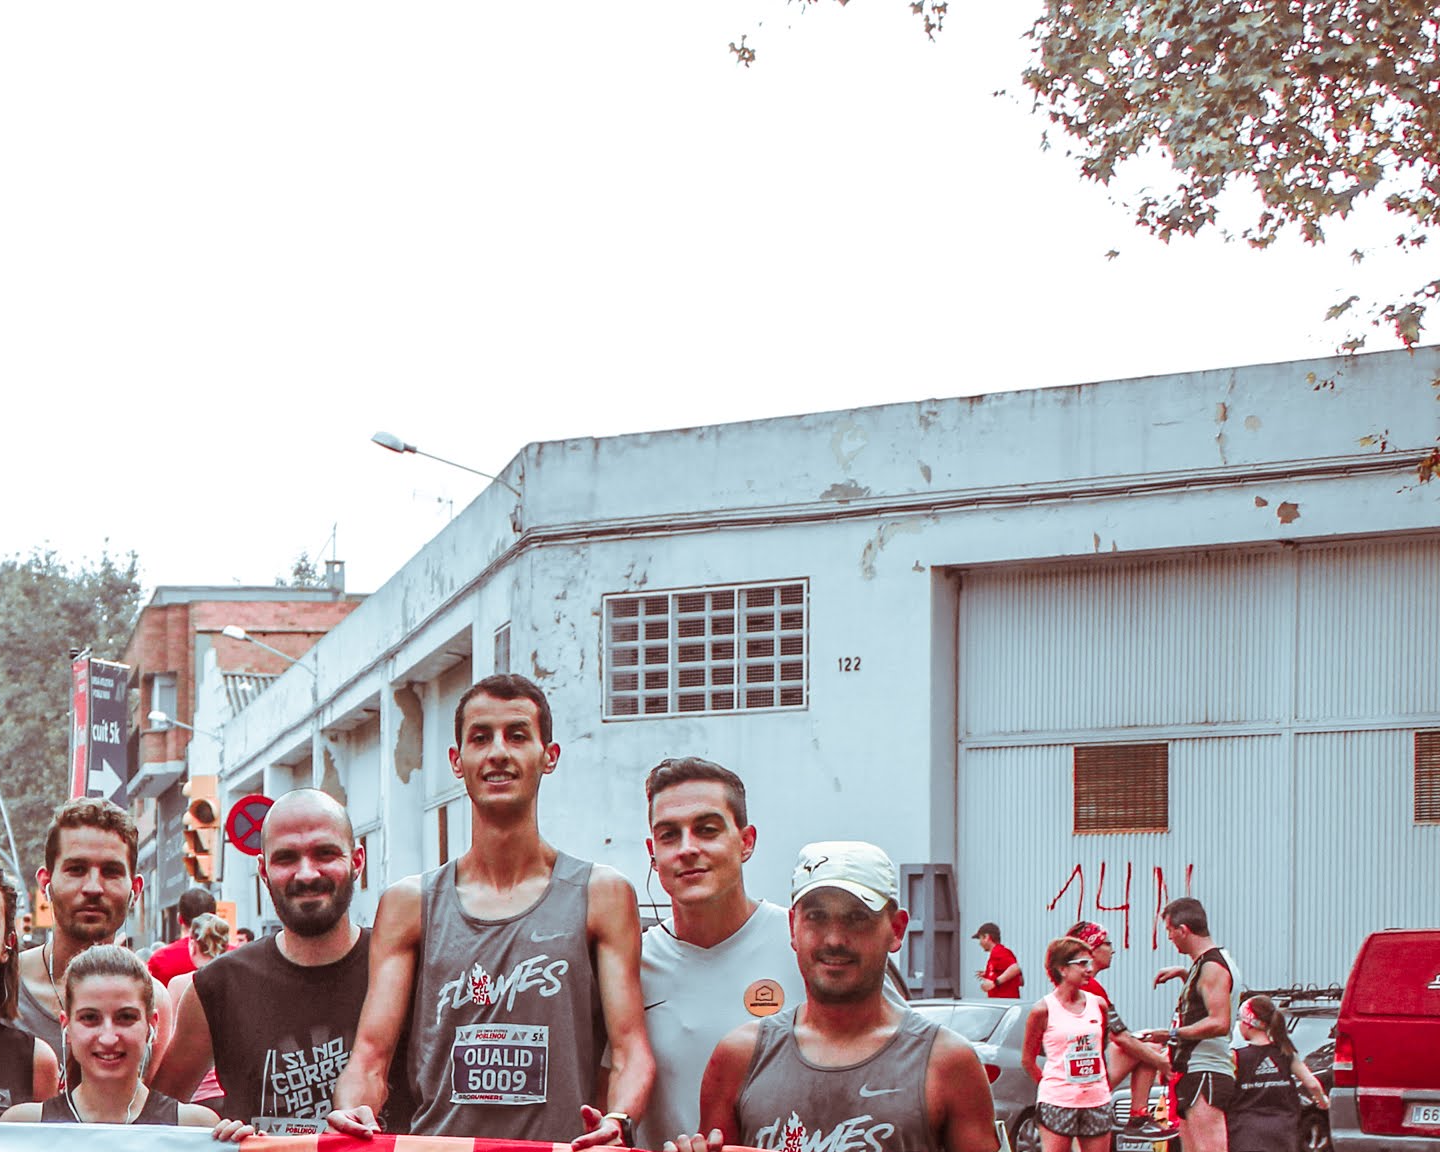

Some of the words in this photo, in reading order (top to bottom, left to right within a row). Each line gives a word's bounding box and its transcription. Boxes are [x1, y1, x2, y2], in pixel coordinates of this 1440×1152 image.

[838, 656, 862, 672] 122
[282, 1049, 307, 1070] SI
[312, 1036, 344, 1063] NO
[463, 1048, 533, 1067] OUALID
[270, 1050, 353, 1095] CORRE
[468, 1070, 527, 1092] 5009
[1423, 1108, 1440, 1122] 66
